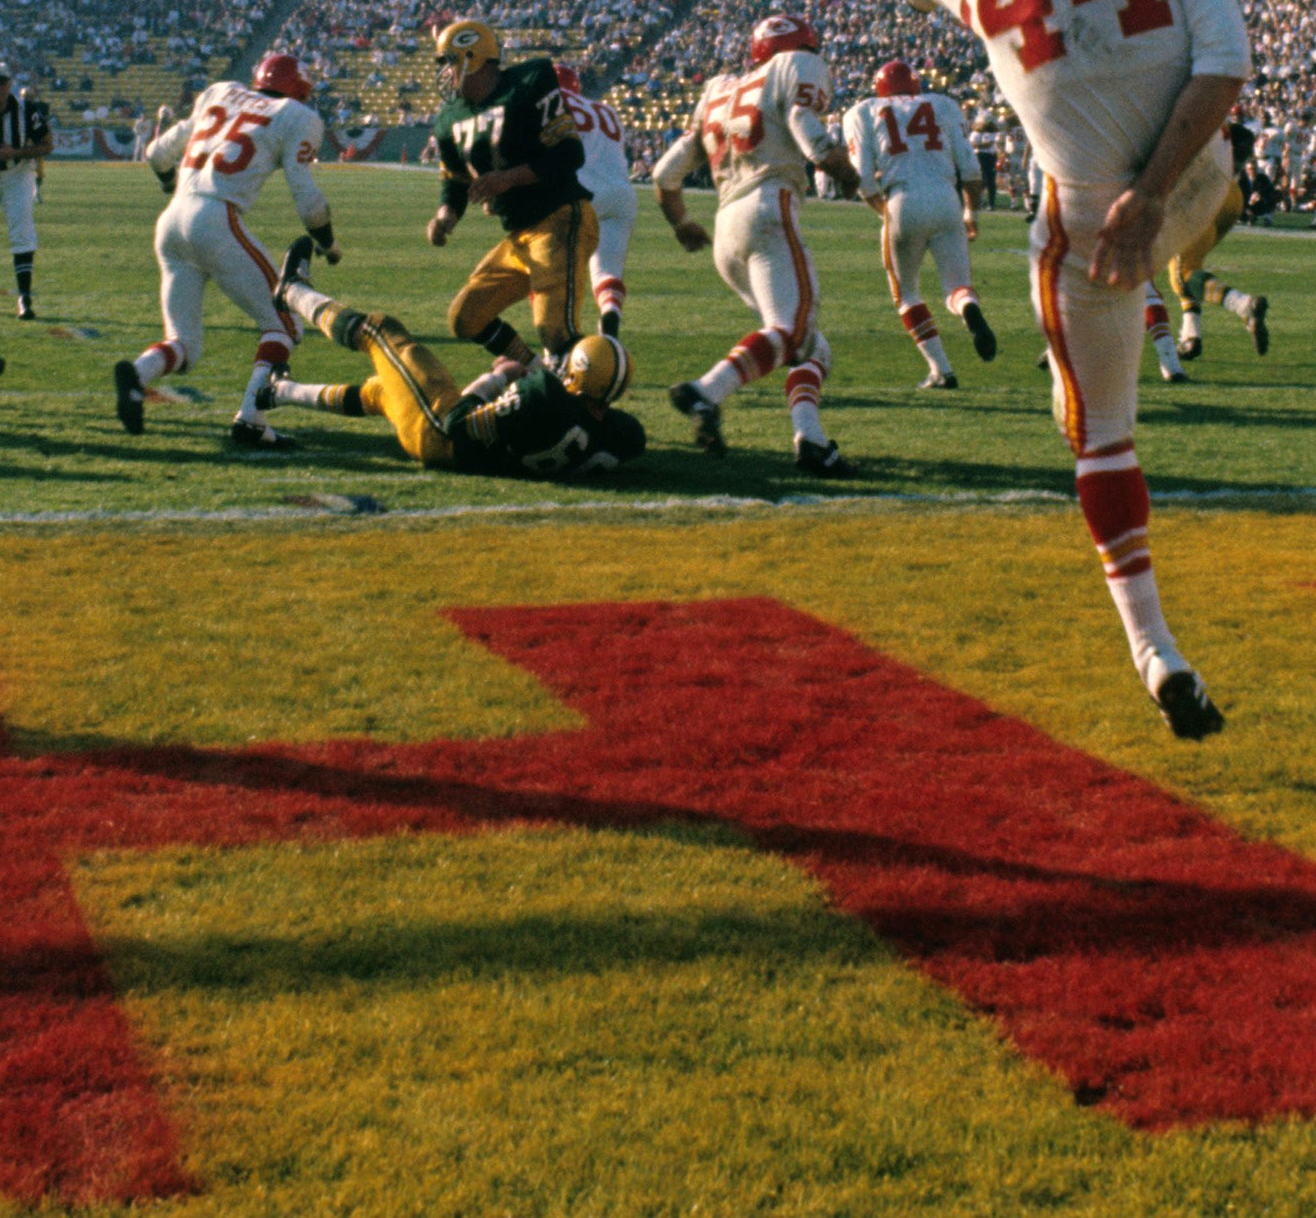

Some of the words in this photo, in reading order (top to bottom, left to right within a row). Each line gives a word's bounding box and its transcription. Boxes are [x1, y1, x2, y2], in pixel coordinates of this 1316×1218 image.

[181, 105, 272, 175] 25
[452, 105, 506, 158] 77
[563, 90, 623, 143] 60
[702, 75, 767, 167] 55
[878, 100, 944, 157] 14
